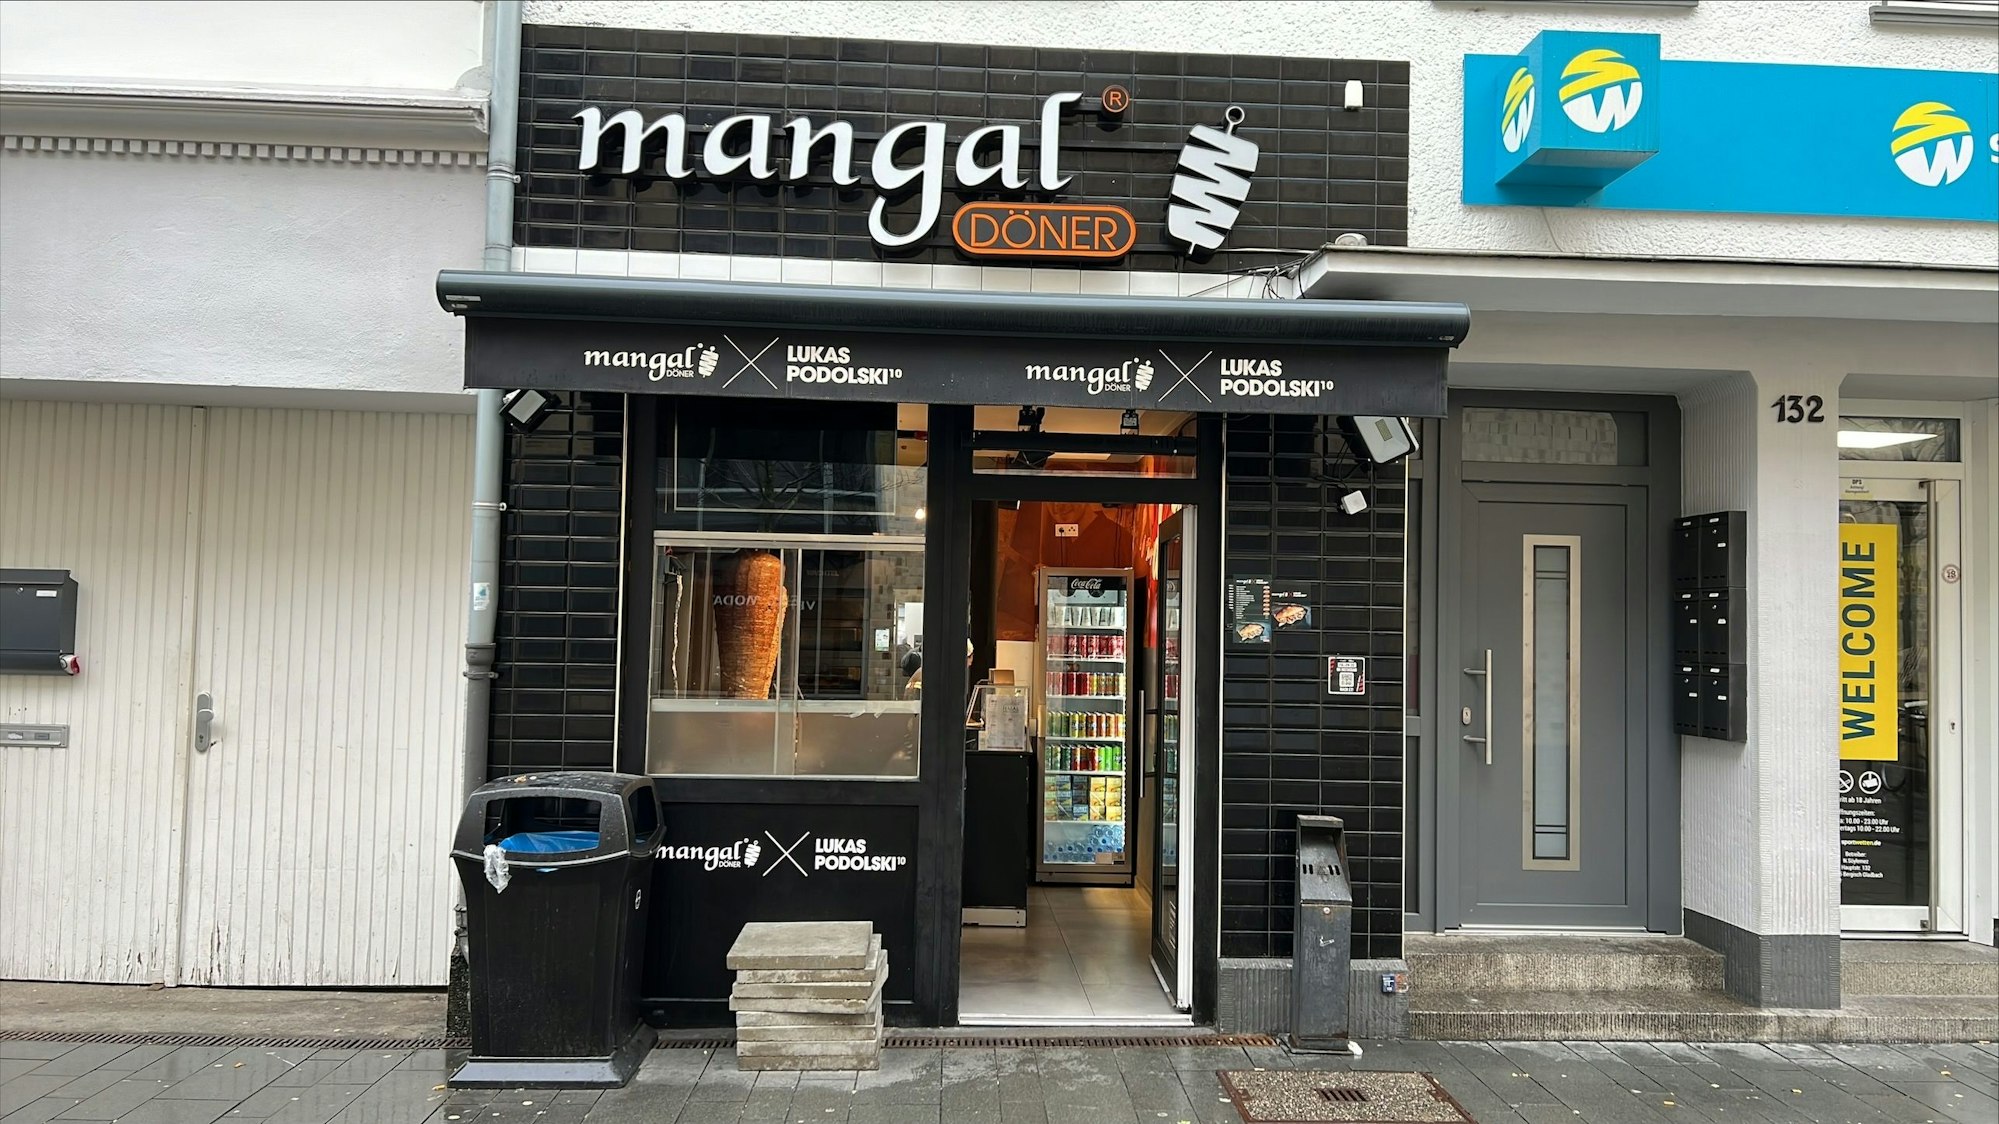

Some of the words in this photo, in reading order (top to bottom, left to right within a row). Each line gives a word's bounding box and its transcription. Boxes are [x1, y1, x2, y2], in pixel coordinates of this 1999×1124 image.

[572, 92, 1083, 248] mangal
[970, 209, 1118, 251] DÖNER
[584, 344, 697, 382] mangal
[787, 344, 851, 364] LUKAS
[1220, 358, 1282, 377] LUKAS
[666, 368, 695, 378] DÖNER
[1025, 360, 1132, 395] mangal
[1104, 383, 1131, 393] DÖNER
[1770, 394, 1825, 424] 132
[1842, 542, 1876, 741] WELCOME
[655, 839, 744, 871] mangal
[815, 838, 867, 854] LUKAS
[718, 859, 742, 868] DÖNER
